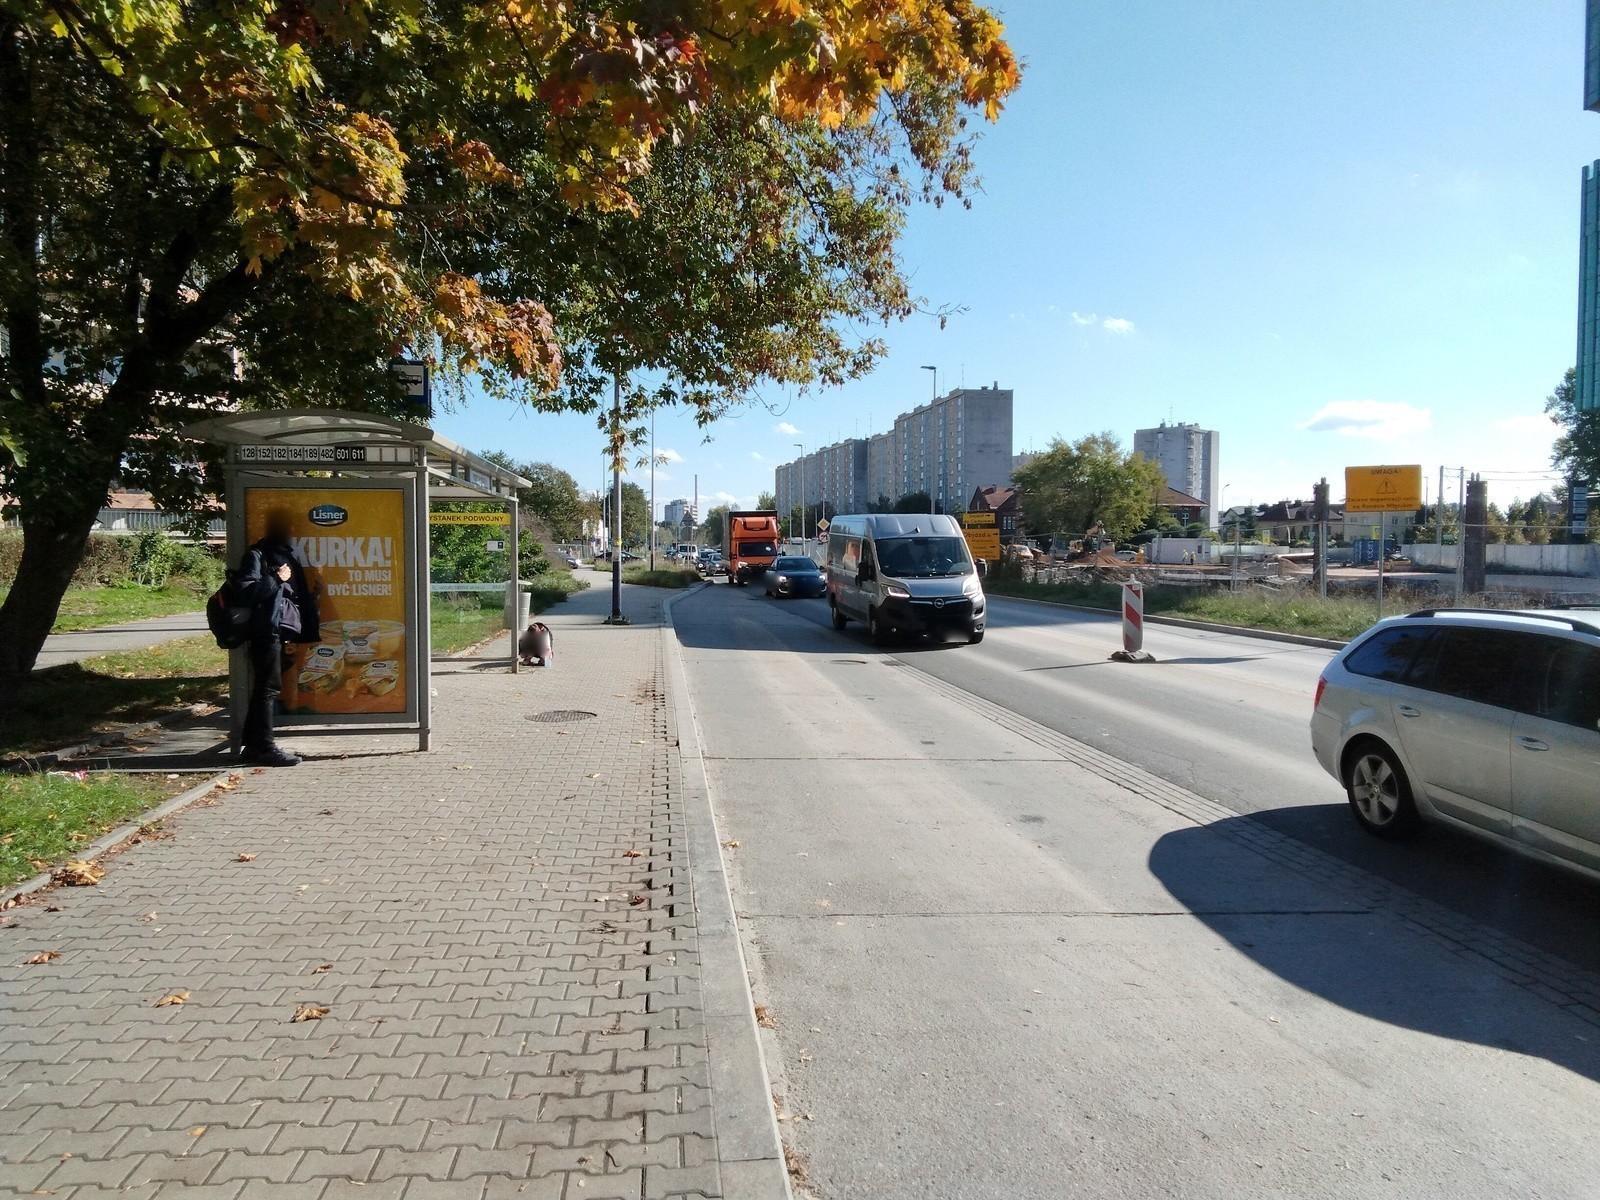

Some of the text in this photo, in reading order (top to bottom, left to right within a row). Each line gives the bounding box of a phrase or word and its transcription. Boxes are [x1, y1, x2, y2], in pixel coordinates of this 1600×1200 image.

[242, 448, 365, 459] 128 152 182 184 189 482 601 611
[312, 509, 345, 520] Lisner
[291, 536, 392, 568] KURKA!
[348, 570, 392, 582] TO MUSI
[327, 583, 392, 596] BYĆ LISNER!
